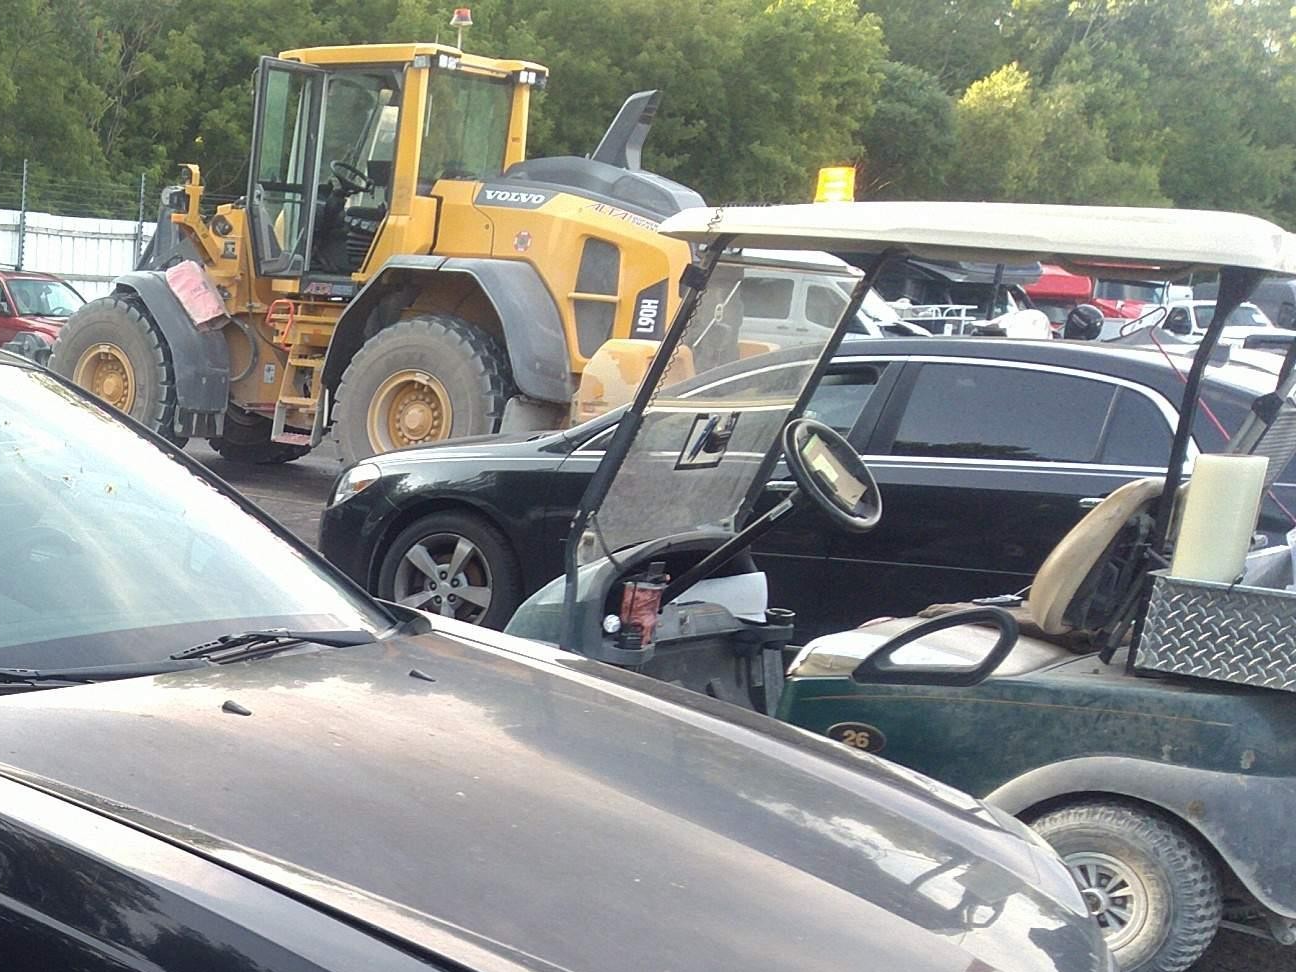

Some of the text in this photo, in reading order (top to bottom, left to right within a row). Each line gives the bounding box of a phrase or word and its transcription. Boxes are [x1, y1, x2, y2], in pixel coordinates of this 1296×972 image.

[485, 189, 546, 204] VOLVO
[636, 299, 659, 332] L90H
[842, 729, 870, 749] 26
